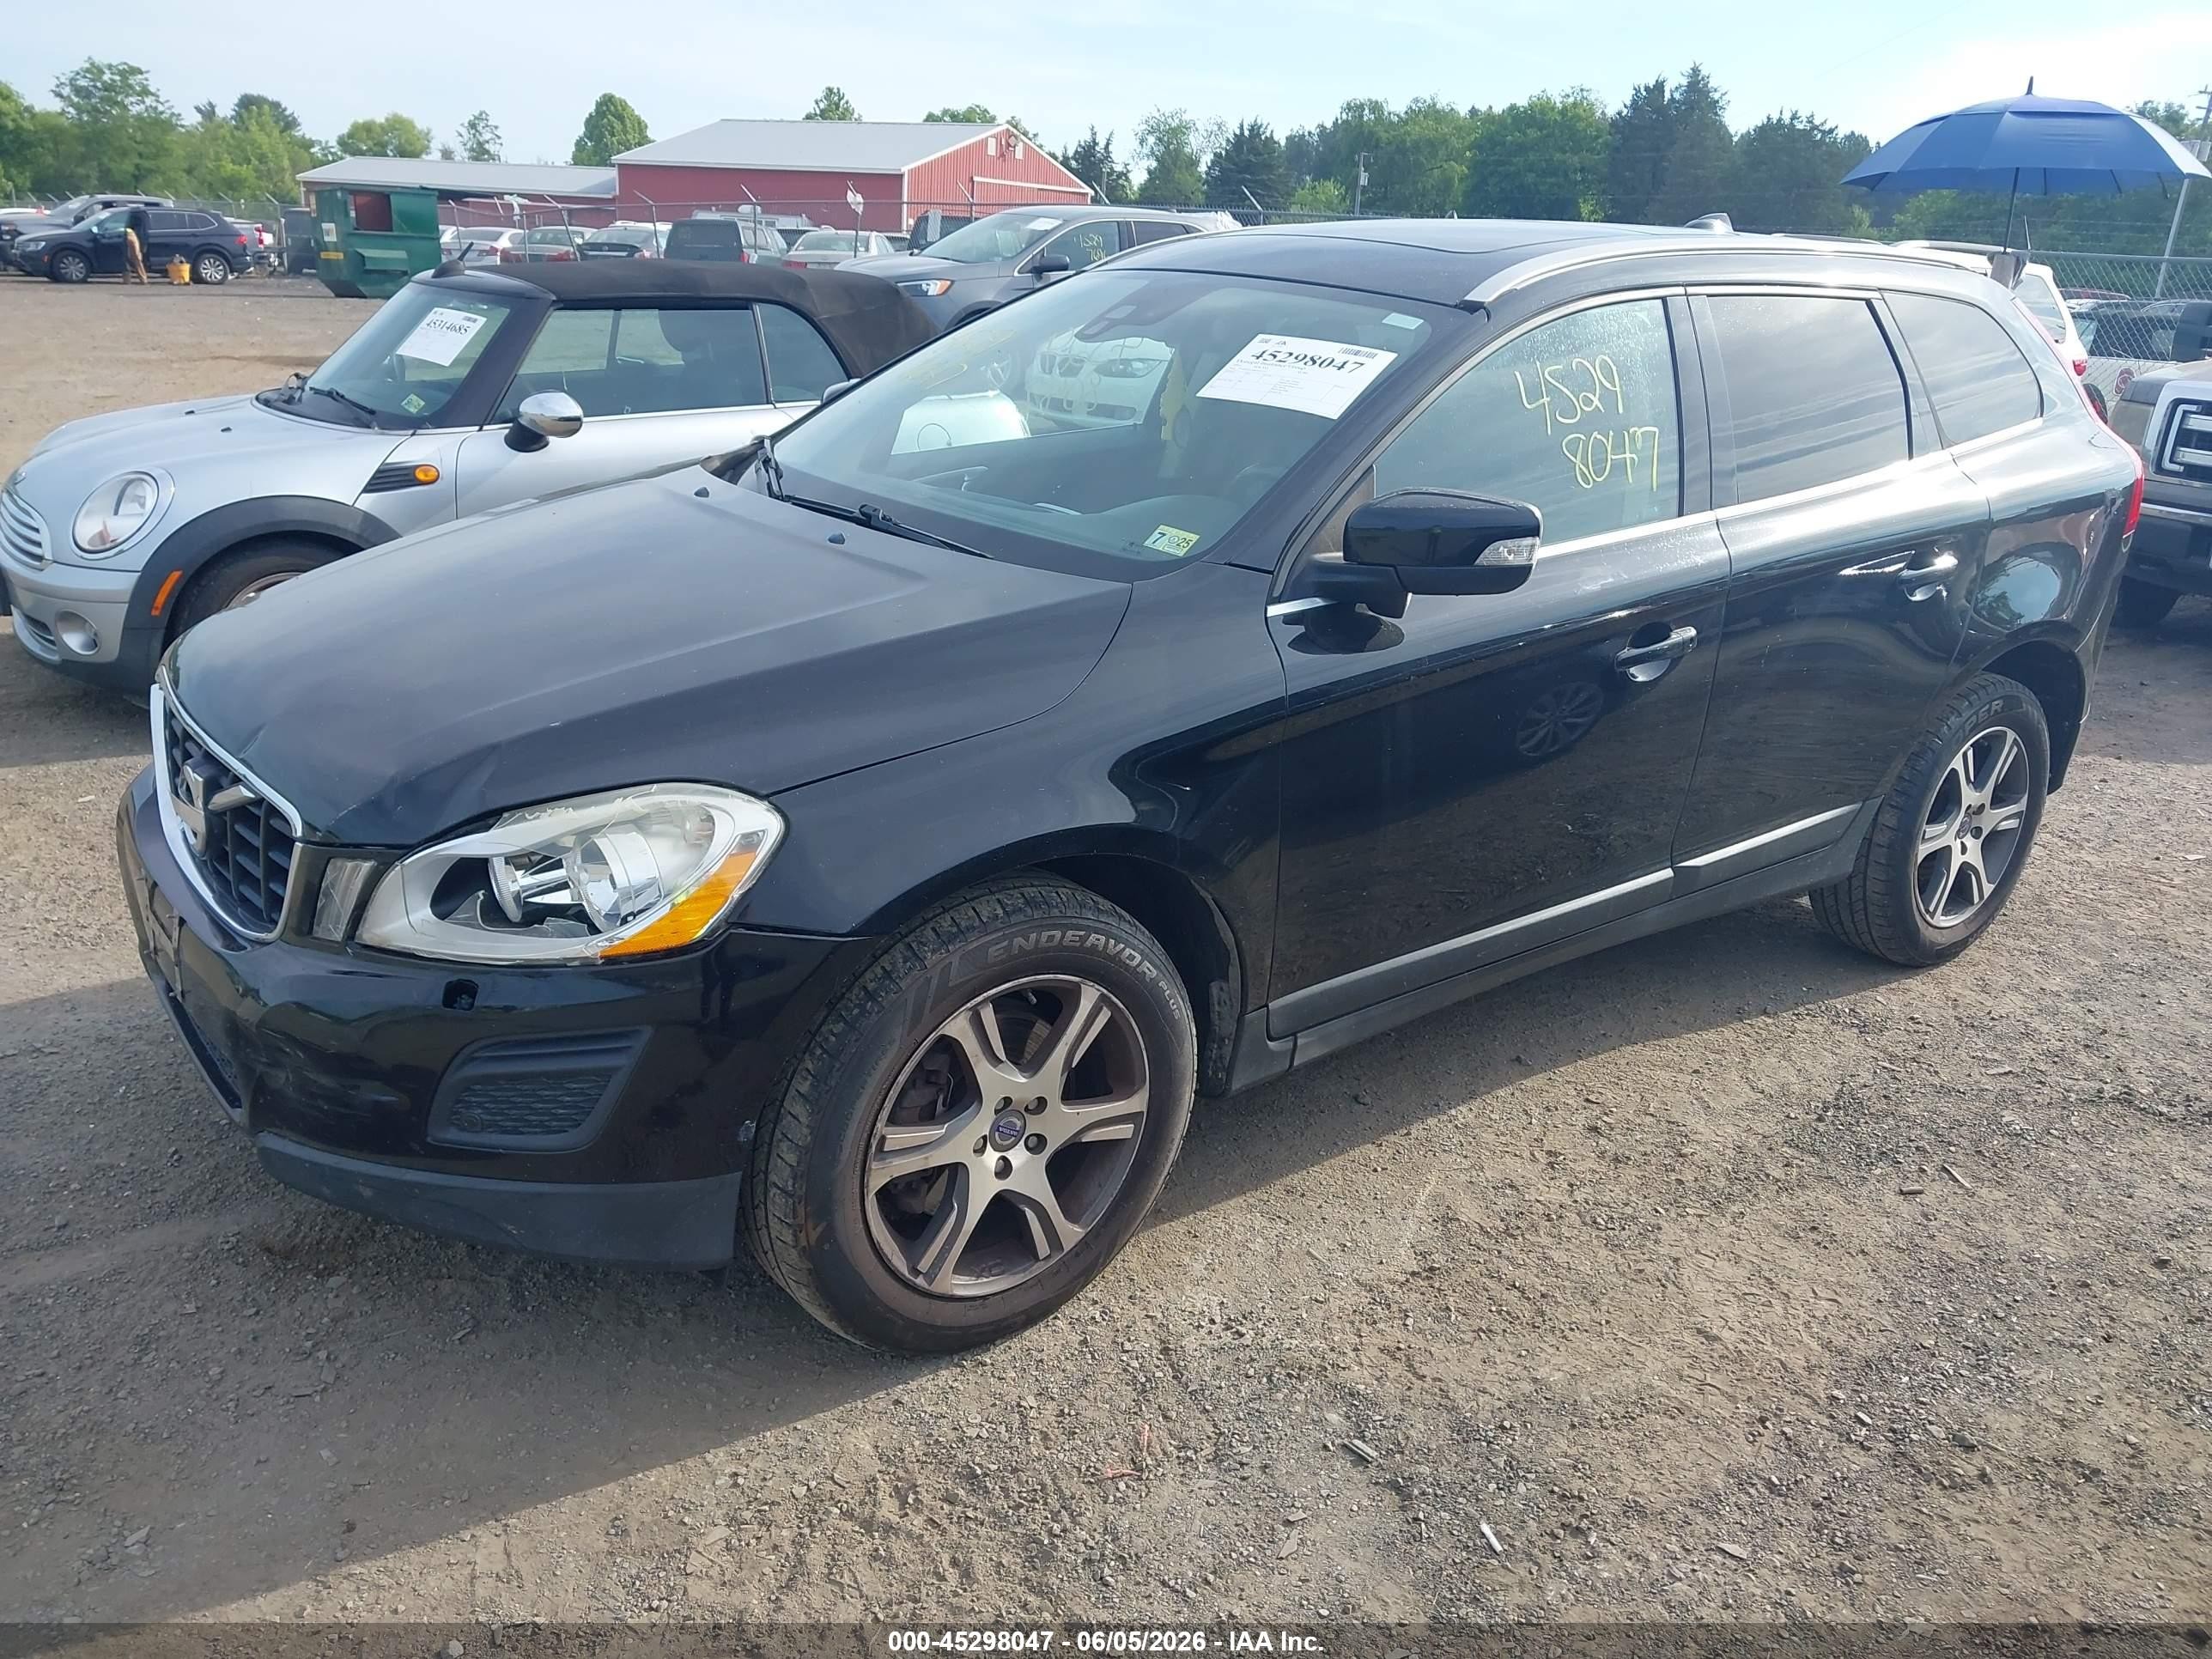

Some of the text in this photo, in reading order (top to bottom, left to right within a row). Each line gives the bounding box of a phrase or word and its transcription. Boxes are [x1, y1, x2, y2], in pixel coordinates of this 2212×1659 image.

[1250, 349, 1365, 374] 45298047
[1514, 355, 1624, 436] 4529
[1561, 426, 1659, 492] 8047
[1152, 532, 1193, 549] 7 25
[988, 930, 1181, 1021] ENDEAVOR PLUS
